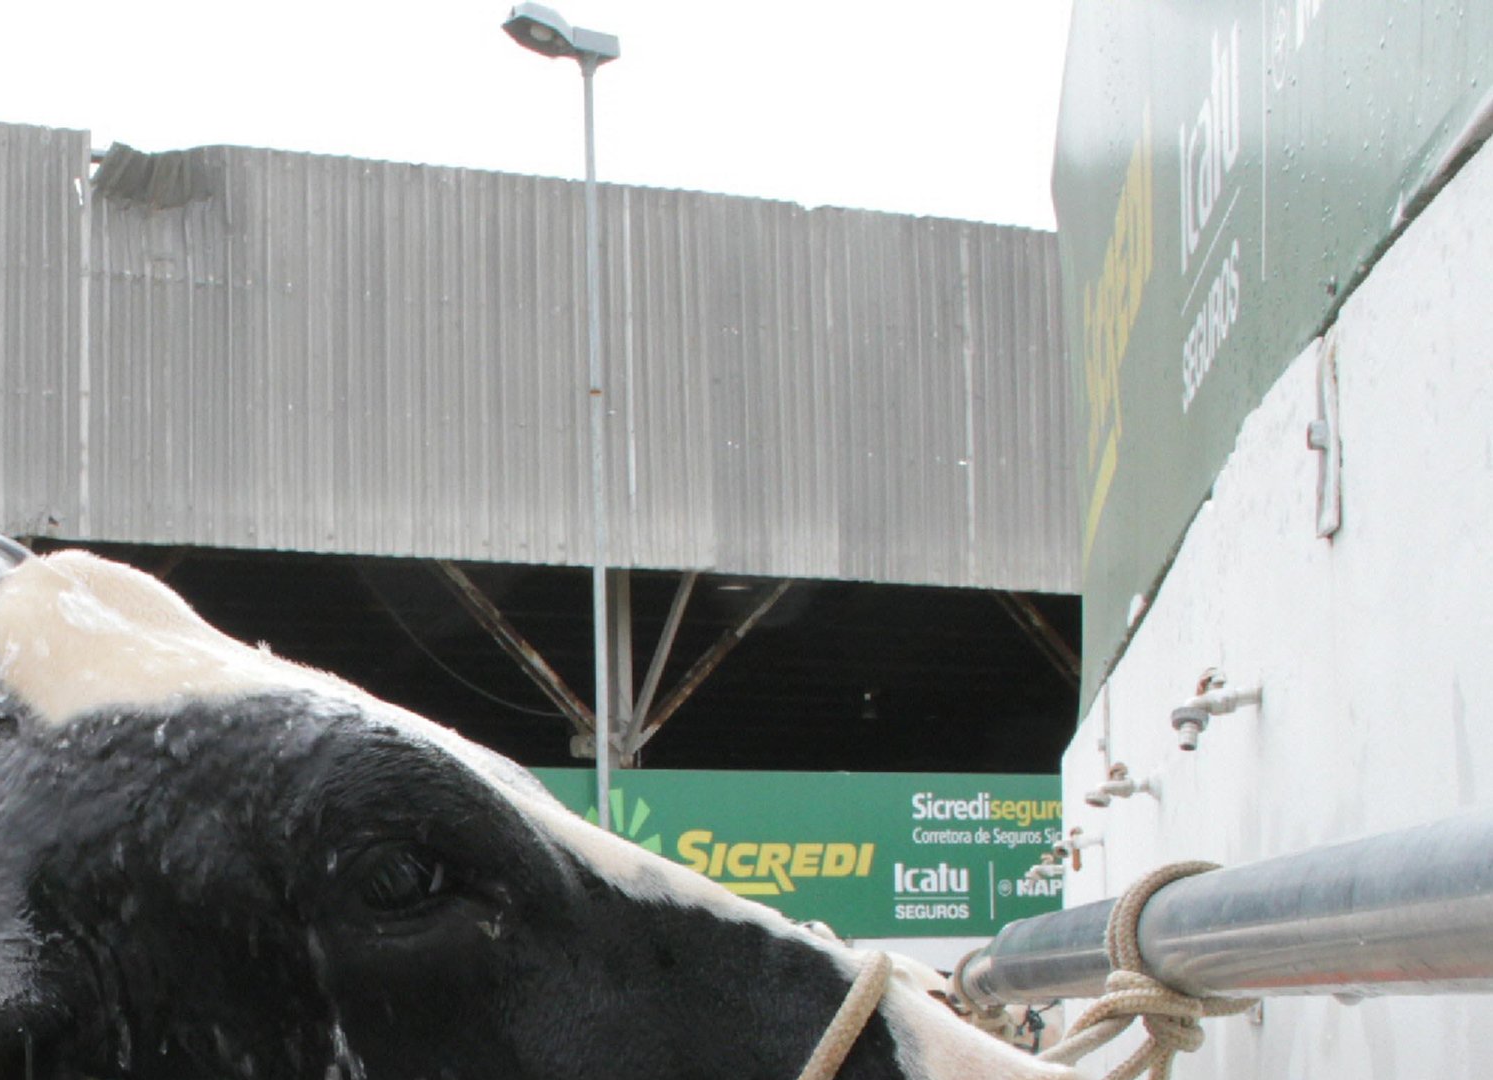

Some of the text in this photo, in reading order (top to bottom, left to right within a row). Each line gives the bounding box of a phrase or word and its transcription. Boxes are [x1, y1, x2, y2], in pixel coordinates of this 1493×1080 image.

[1179, 19, 1241, 275] Icatu
[1182, 238, 1240, 415] SEGUROS
[912, 827, 973, 844] Corretora
[974, 826, 991, 844] de
[993, 828, 1042, 848] Seguros
[677, 829, 875, 893] SICREDI
[894, 863, 970, 893] Icatu
[895, 903, 970, 919] SEGUROS
